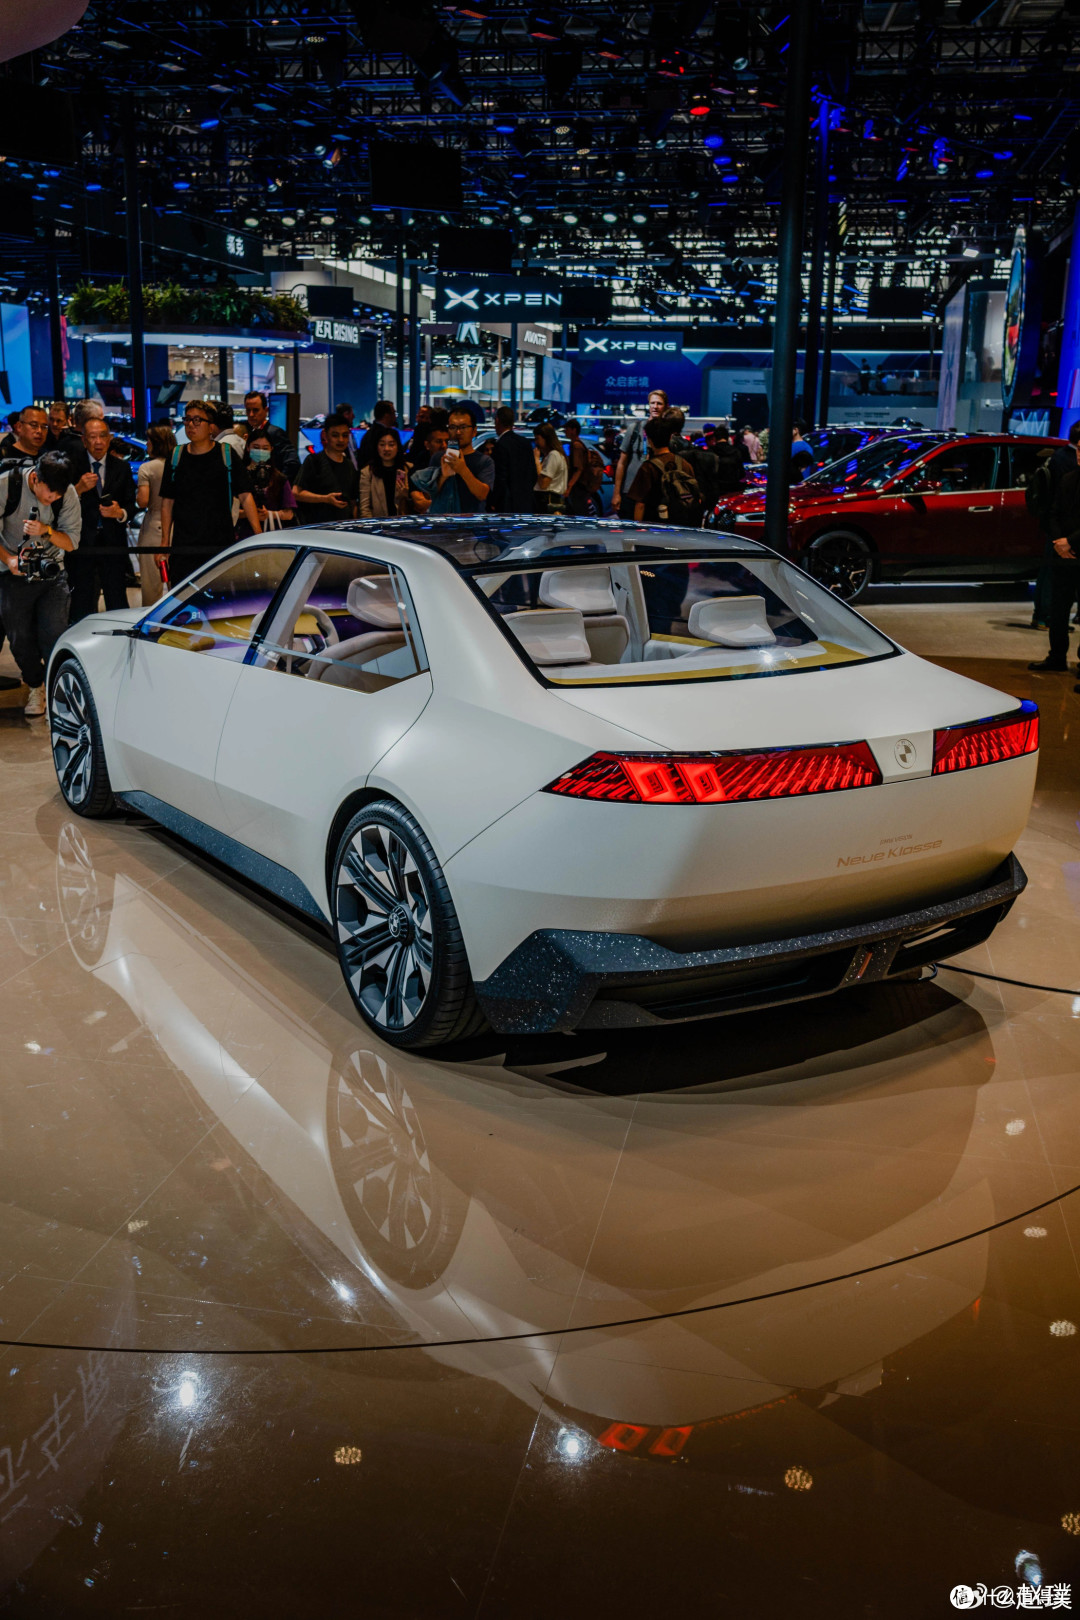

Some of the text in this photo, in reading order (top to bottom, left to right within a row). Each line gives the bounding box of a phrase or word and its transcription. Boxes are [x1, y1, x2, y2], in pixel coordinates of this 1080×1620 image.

[333, 322, 359, 344] RISING
[610, 341, 677, 351] XPENG
[837, 840, 943, 868] Neue Klasse
